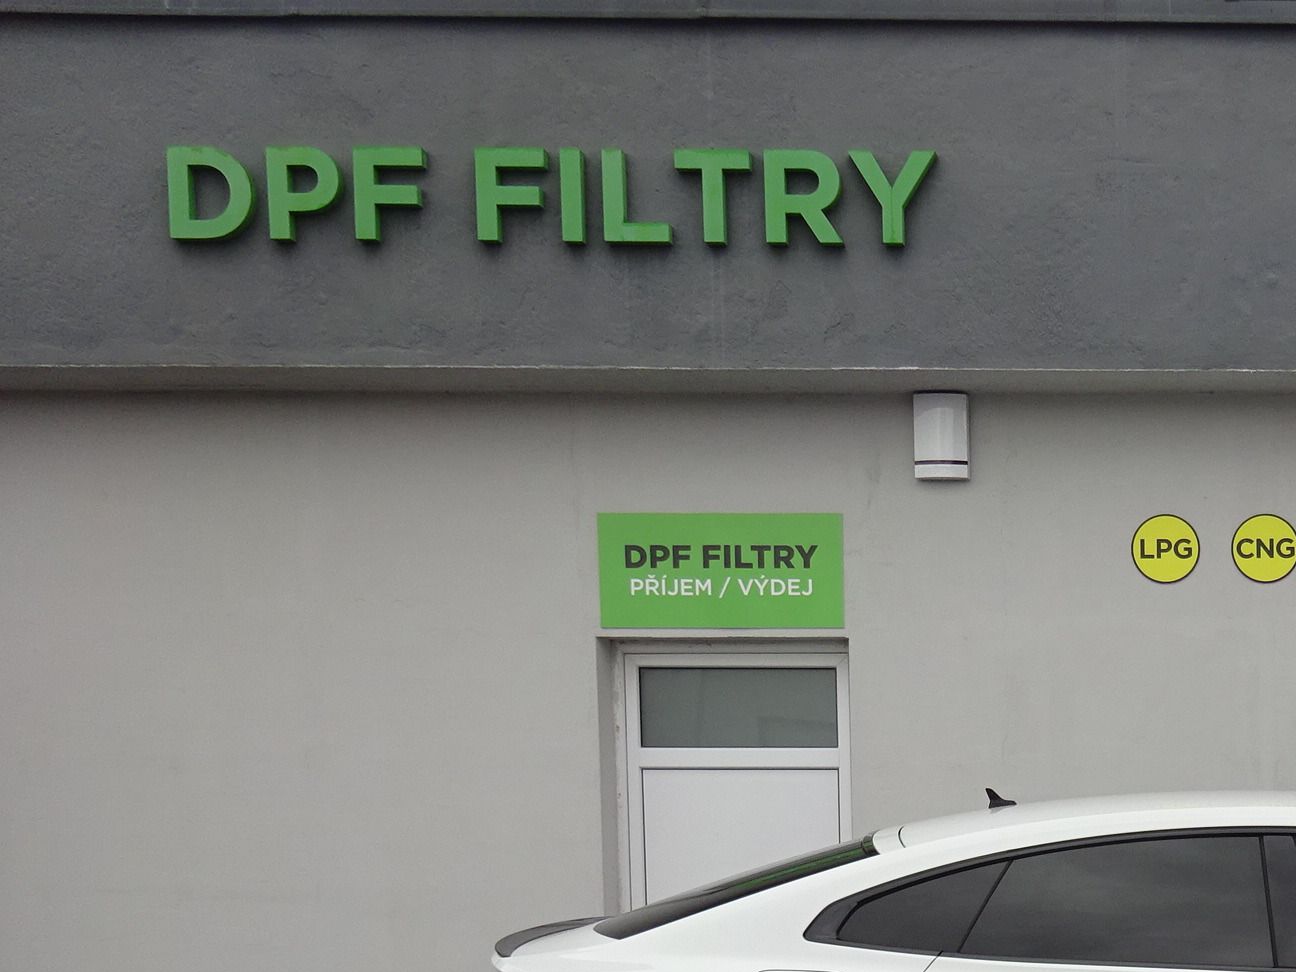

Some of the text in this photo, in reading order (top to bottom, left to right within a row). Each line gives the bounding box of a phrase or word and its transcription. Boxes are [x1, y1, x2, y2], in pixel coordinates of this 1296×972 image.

[166, 145, 938, 247] DPF FILTRY
[624, 544, 819, 569] DPF FILTRY
[1140, 538, 1193, 560] LPG
[1236, 538, 1296, 560] CNG
[630, 574, 813, 599] PŘÍJEM / VÝDEJ
